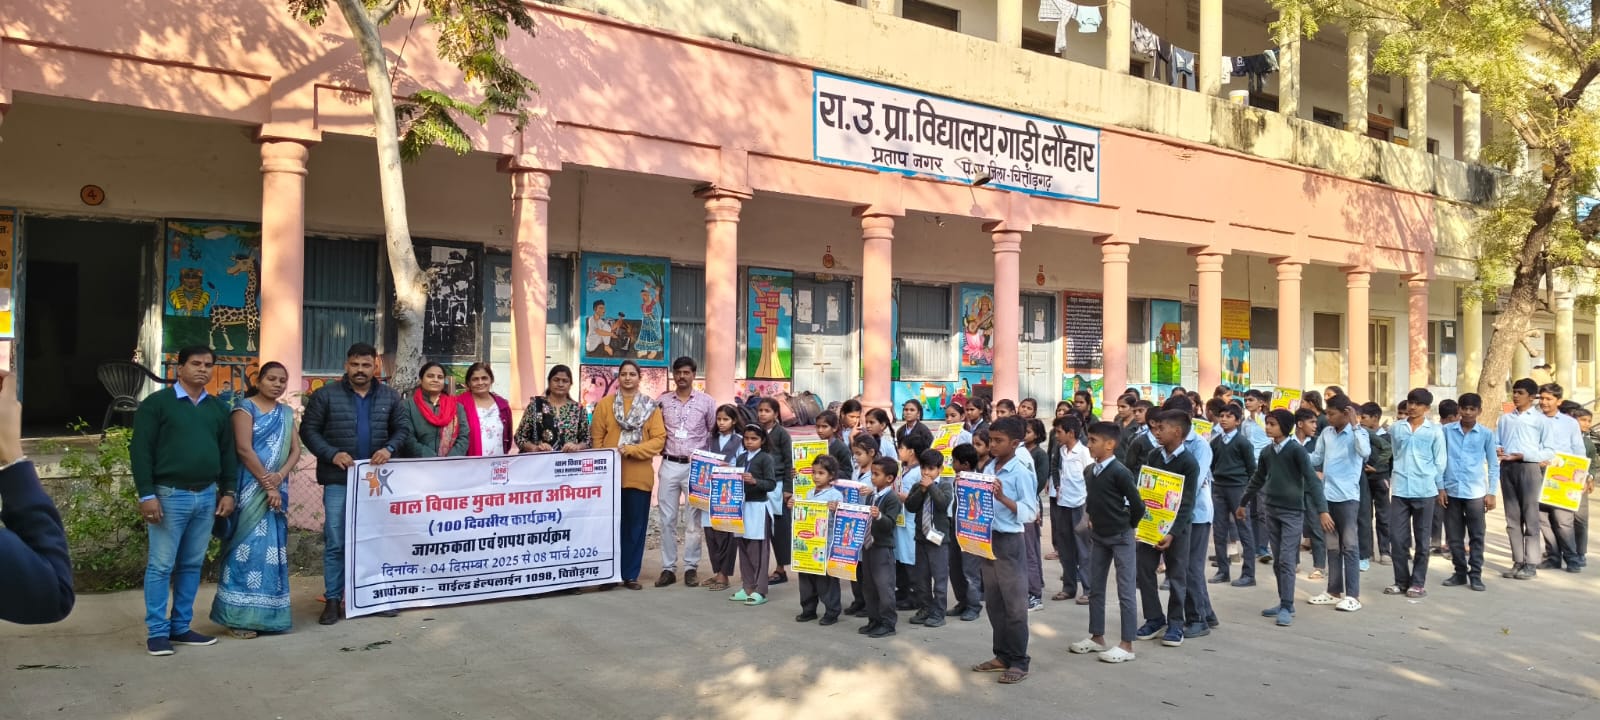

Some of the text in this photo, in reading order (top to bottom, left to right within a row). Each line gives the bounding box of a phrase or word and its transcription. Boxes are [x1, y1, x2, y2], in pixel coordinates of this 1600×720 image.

[871, 146, 910, 168] प्रताप
[912, 152, 945, 173] नगर
[389, 484, 602, 515] बाल विवाह मुक्त भारत अभियान
[464, 513, 510, 530] दिवसीय
[511, 508, 562, 525] कार्यक्रम)
[478, 531, 497, 550] एवं
[497, 533, 526, 549] शपथ
[527, 526, 572, 545] कार्यक्रम
[381, 561, 420, 578] दिनांक
[430, 562, 446, 574] 04
[449, 558, 490, 573] दिसम्बर
[491, 555, 519, 569] 2025
[521, 550, 531, 565] से
[533, 551, 547, 563] 08
[549, 545, 571, 561] मार्च
[573, 546, 599, 560] 2026
[526, 571, 556, 583] 1098,
